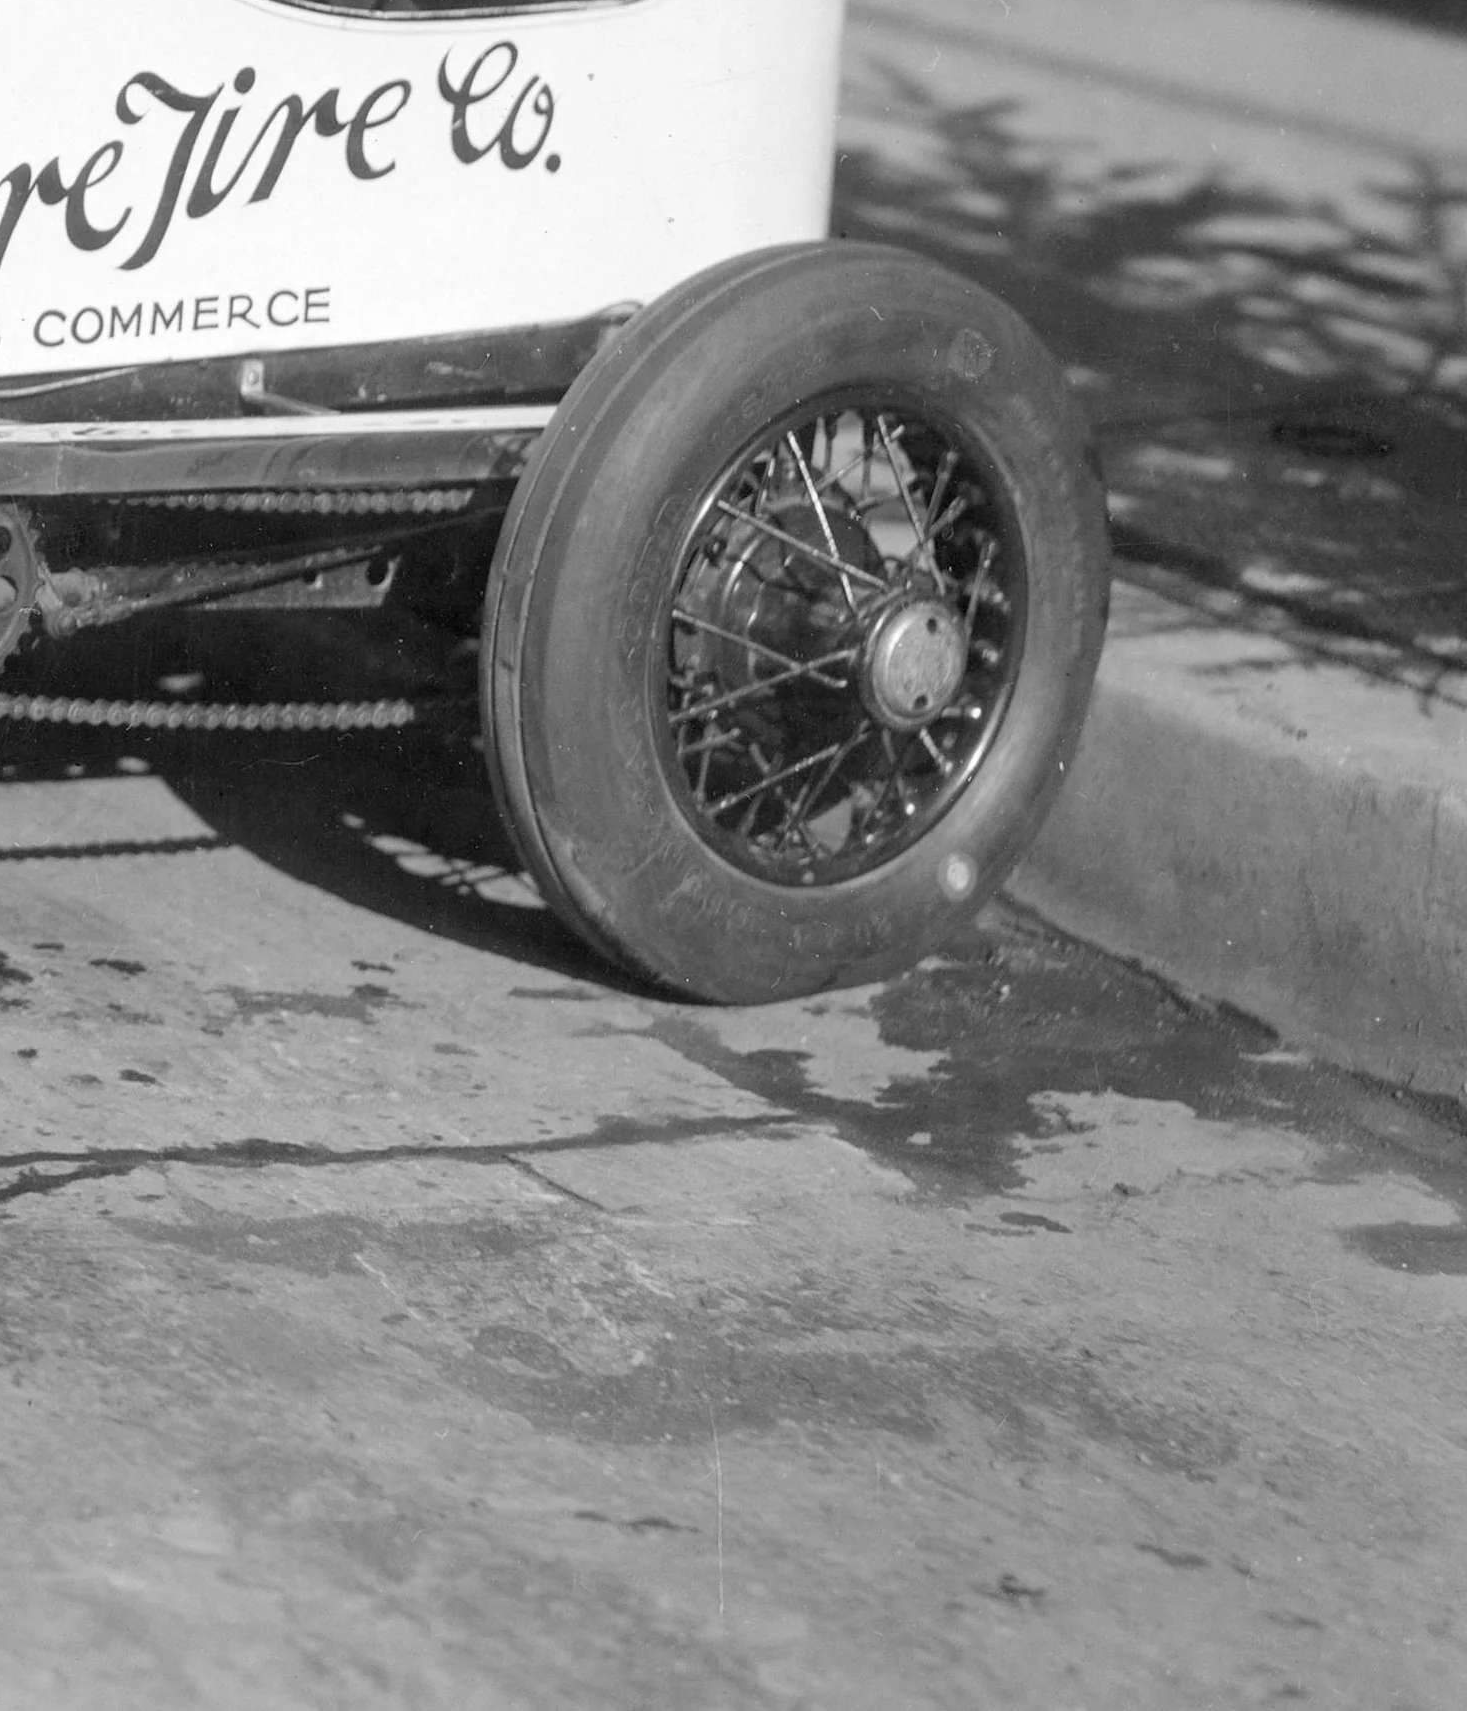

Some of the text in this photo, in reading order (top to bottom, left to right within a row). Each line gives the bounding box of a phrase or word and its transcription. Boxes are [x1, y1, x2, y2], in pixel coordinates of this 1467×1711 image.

[114, 66, 413, 272] Tire
[437, 40, 562, 173] Co.
[32, 285, 332, 348] COMMERCE
